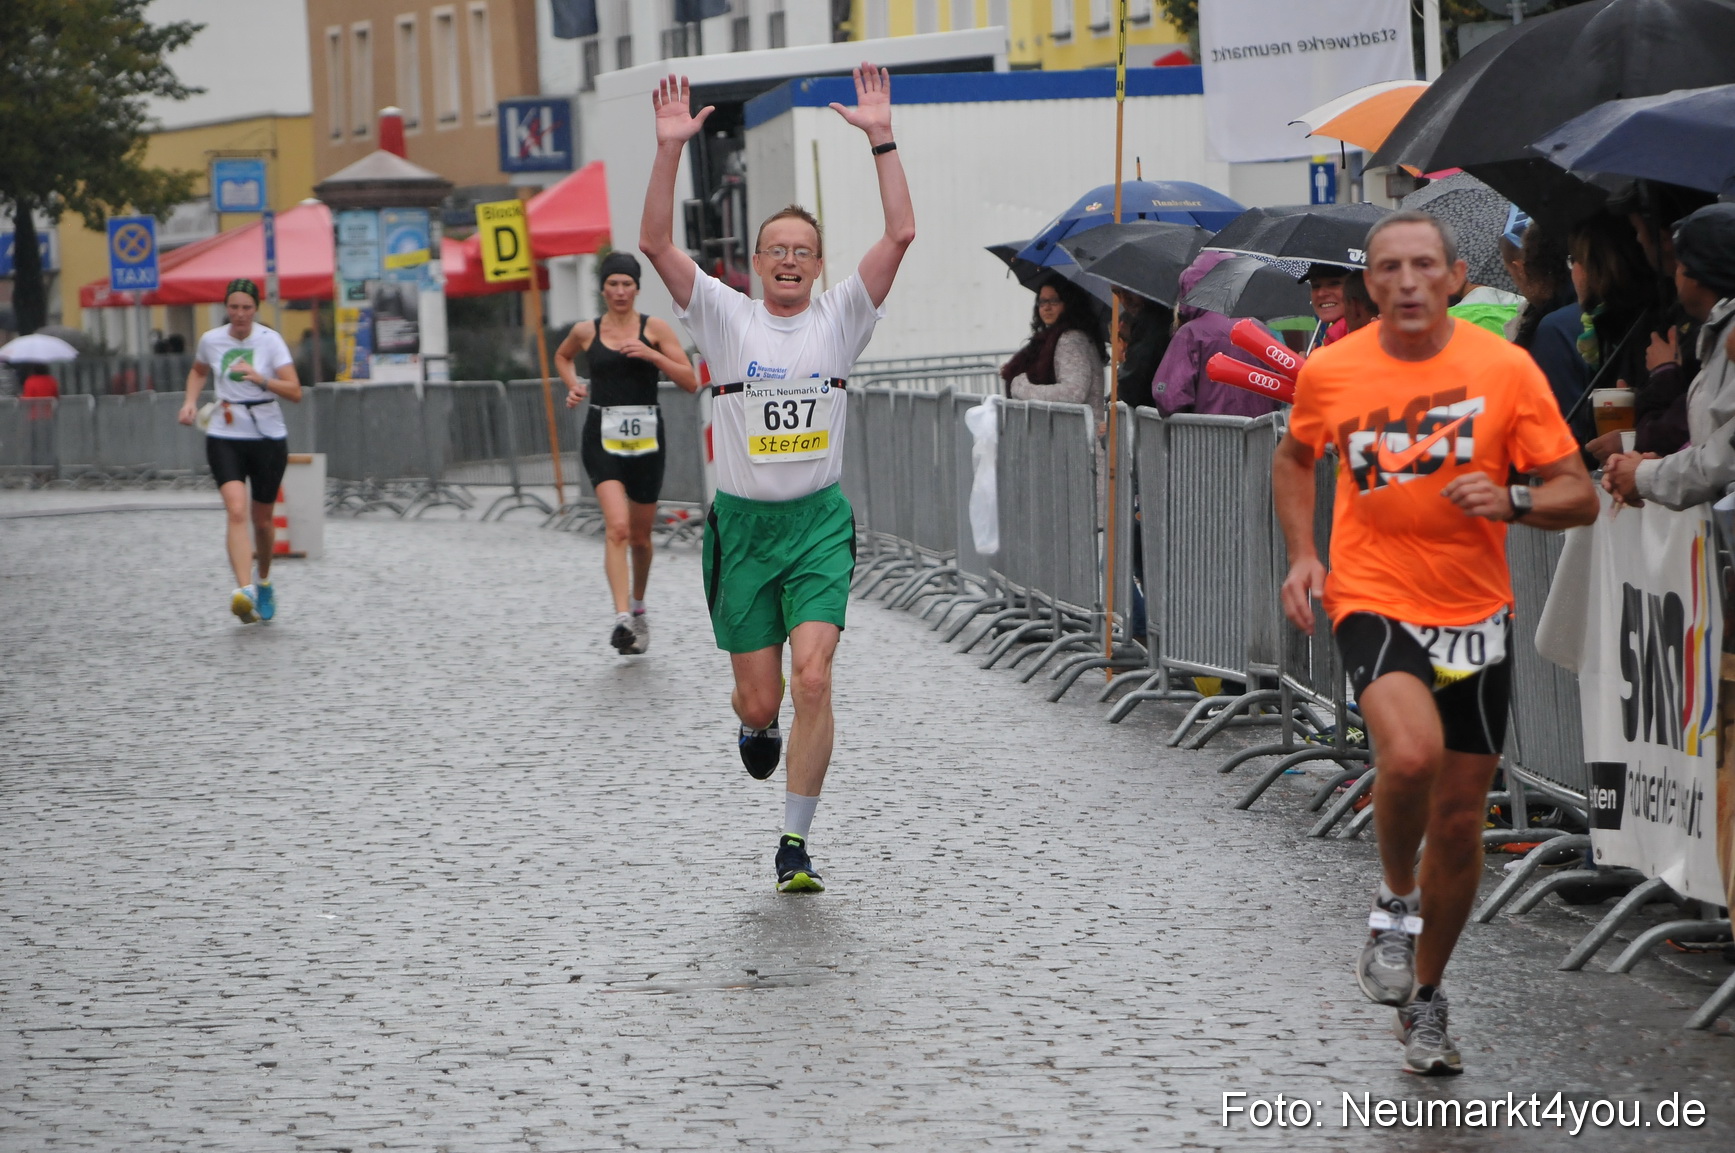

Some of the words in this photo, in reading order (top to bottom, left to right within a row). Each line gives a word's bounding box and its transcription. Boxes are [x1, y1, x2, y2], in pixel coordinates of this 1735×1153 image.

[494, 226, 519, 261] D
[115, 267, 156, 285] TAXI
[745, 389, 775, 397] PARTL
[777, 387, 818, 396] Neumarkt
[764, 399, 817, 430] 637
[619, 418, 641, 436] 46
[759, 435, 821, 452] Stefan
[1420, 626, 1486, 665] 270
